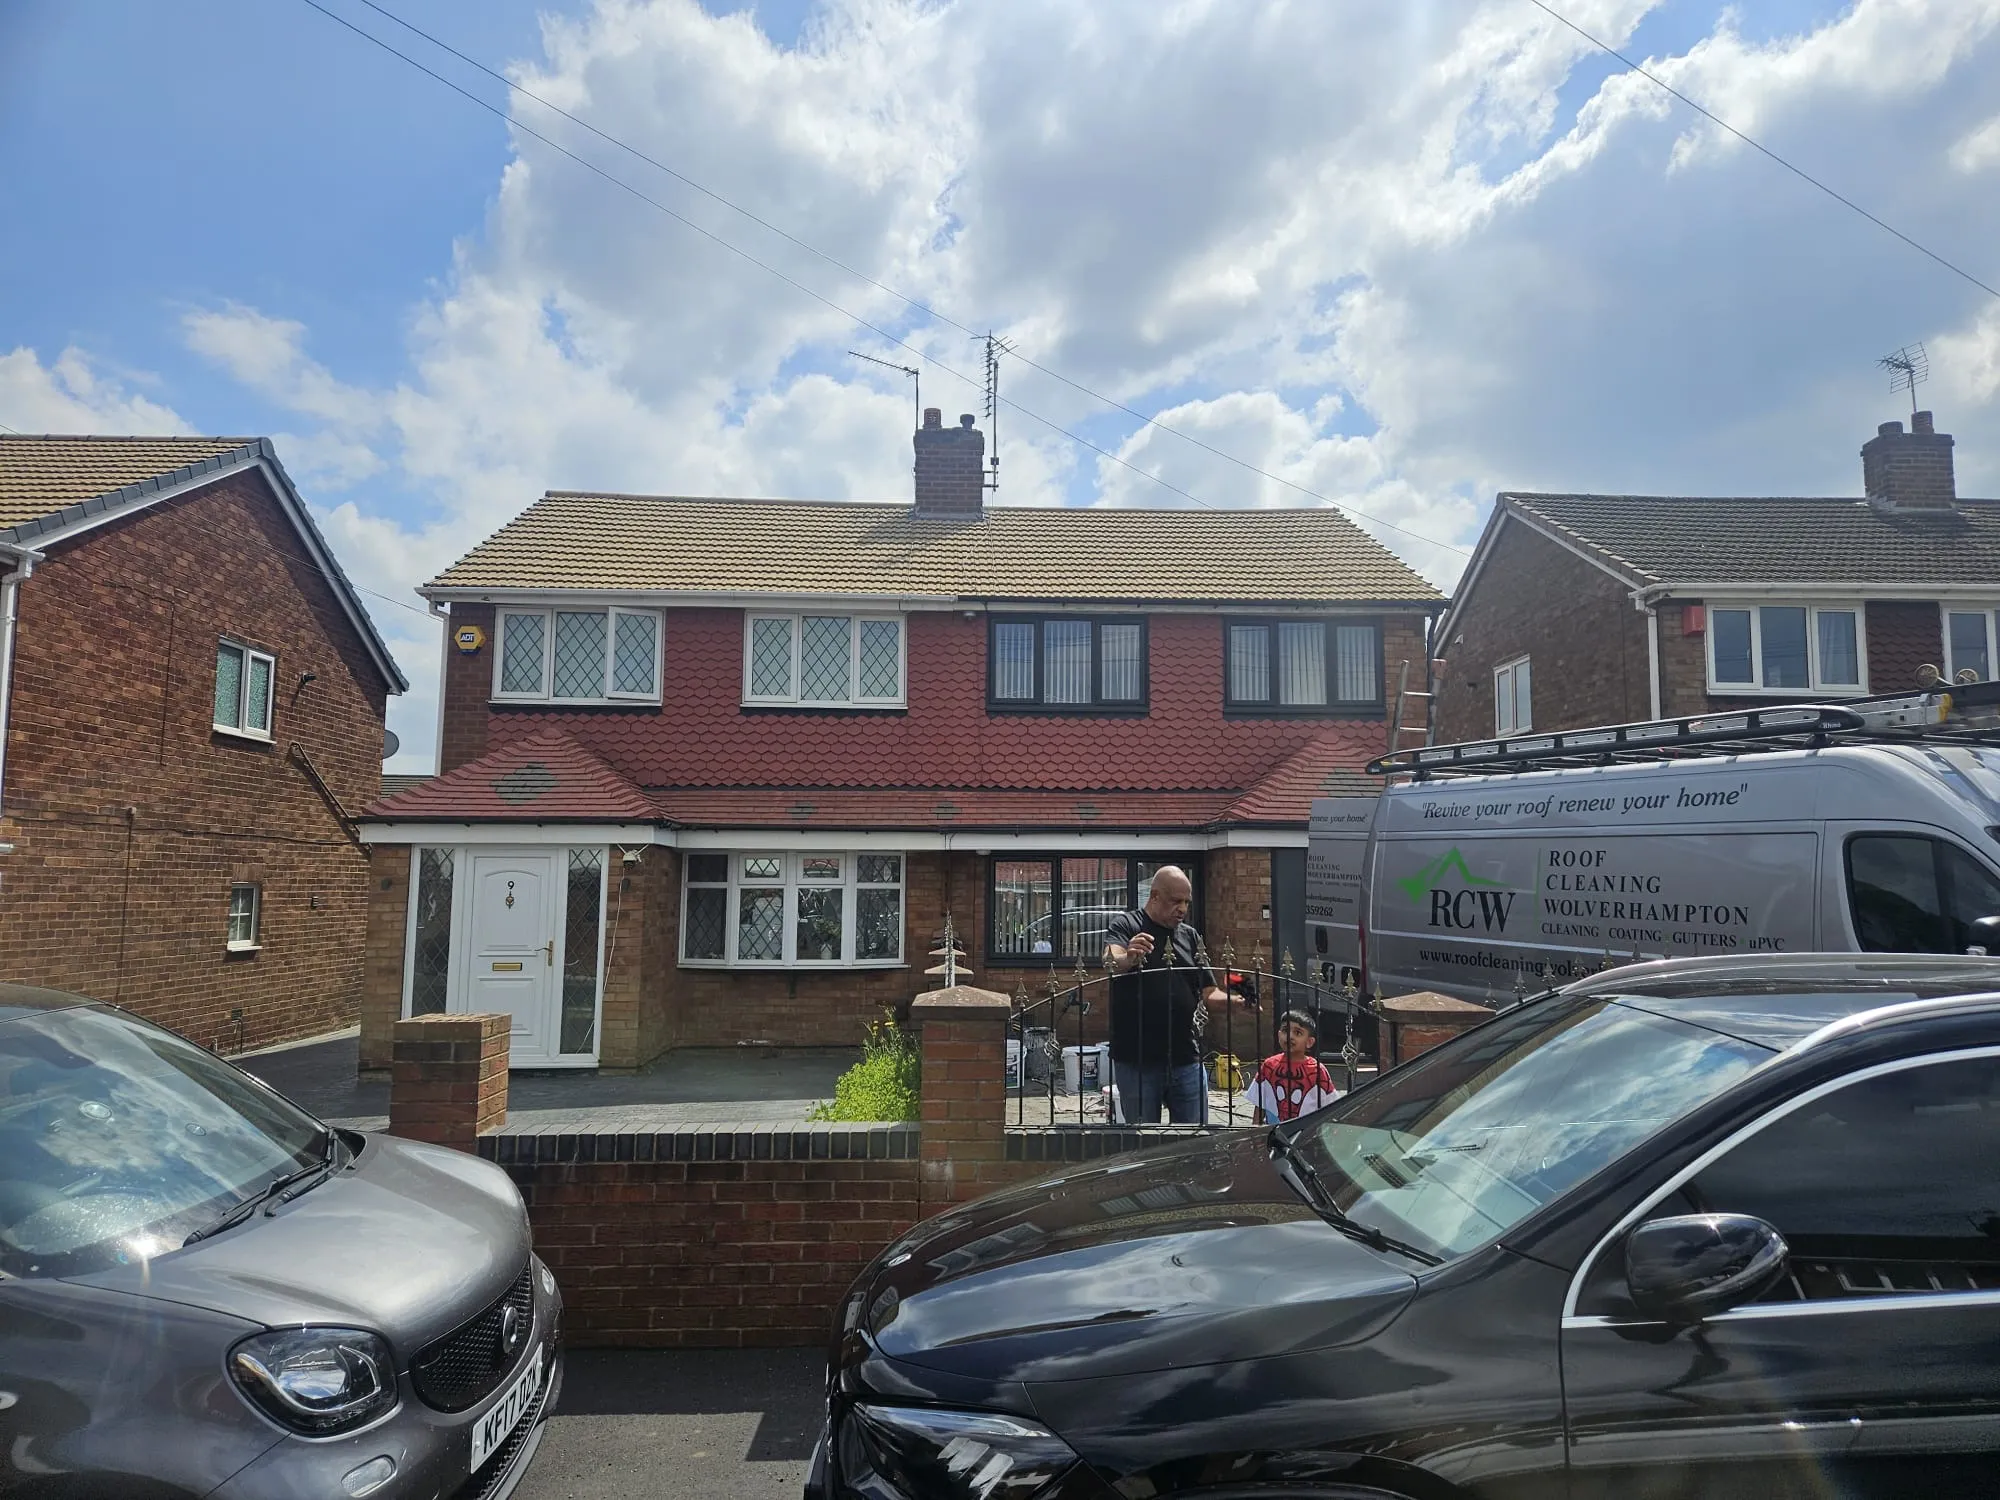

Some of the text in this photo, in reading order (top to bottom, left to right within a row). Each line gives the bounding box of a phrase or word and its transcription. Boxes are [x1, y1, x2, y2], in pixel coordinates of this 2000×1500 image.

[461, 633, 474, 641] ADT
[1475, 803, 1511, 820] your
[1516, 795, 1555, 818] roof
[1558, 797, 1615, 813] renew
[1621, 795, 1670, 815] your
[1549, 850, 1607, 867] ROOF
[508, 880, 515, 890] 9
[1546, 873, 1661, 894] CLEANING
[1428, 889, 1516, 933] RCW
[1544, 898, 1749, 925] WOLVERHAMPTON
[1541, 922, 1785, 950] CLEANING COATING GUTTERS uPVC
[483, 1389, 517, 1455] KF17
